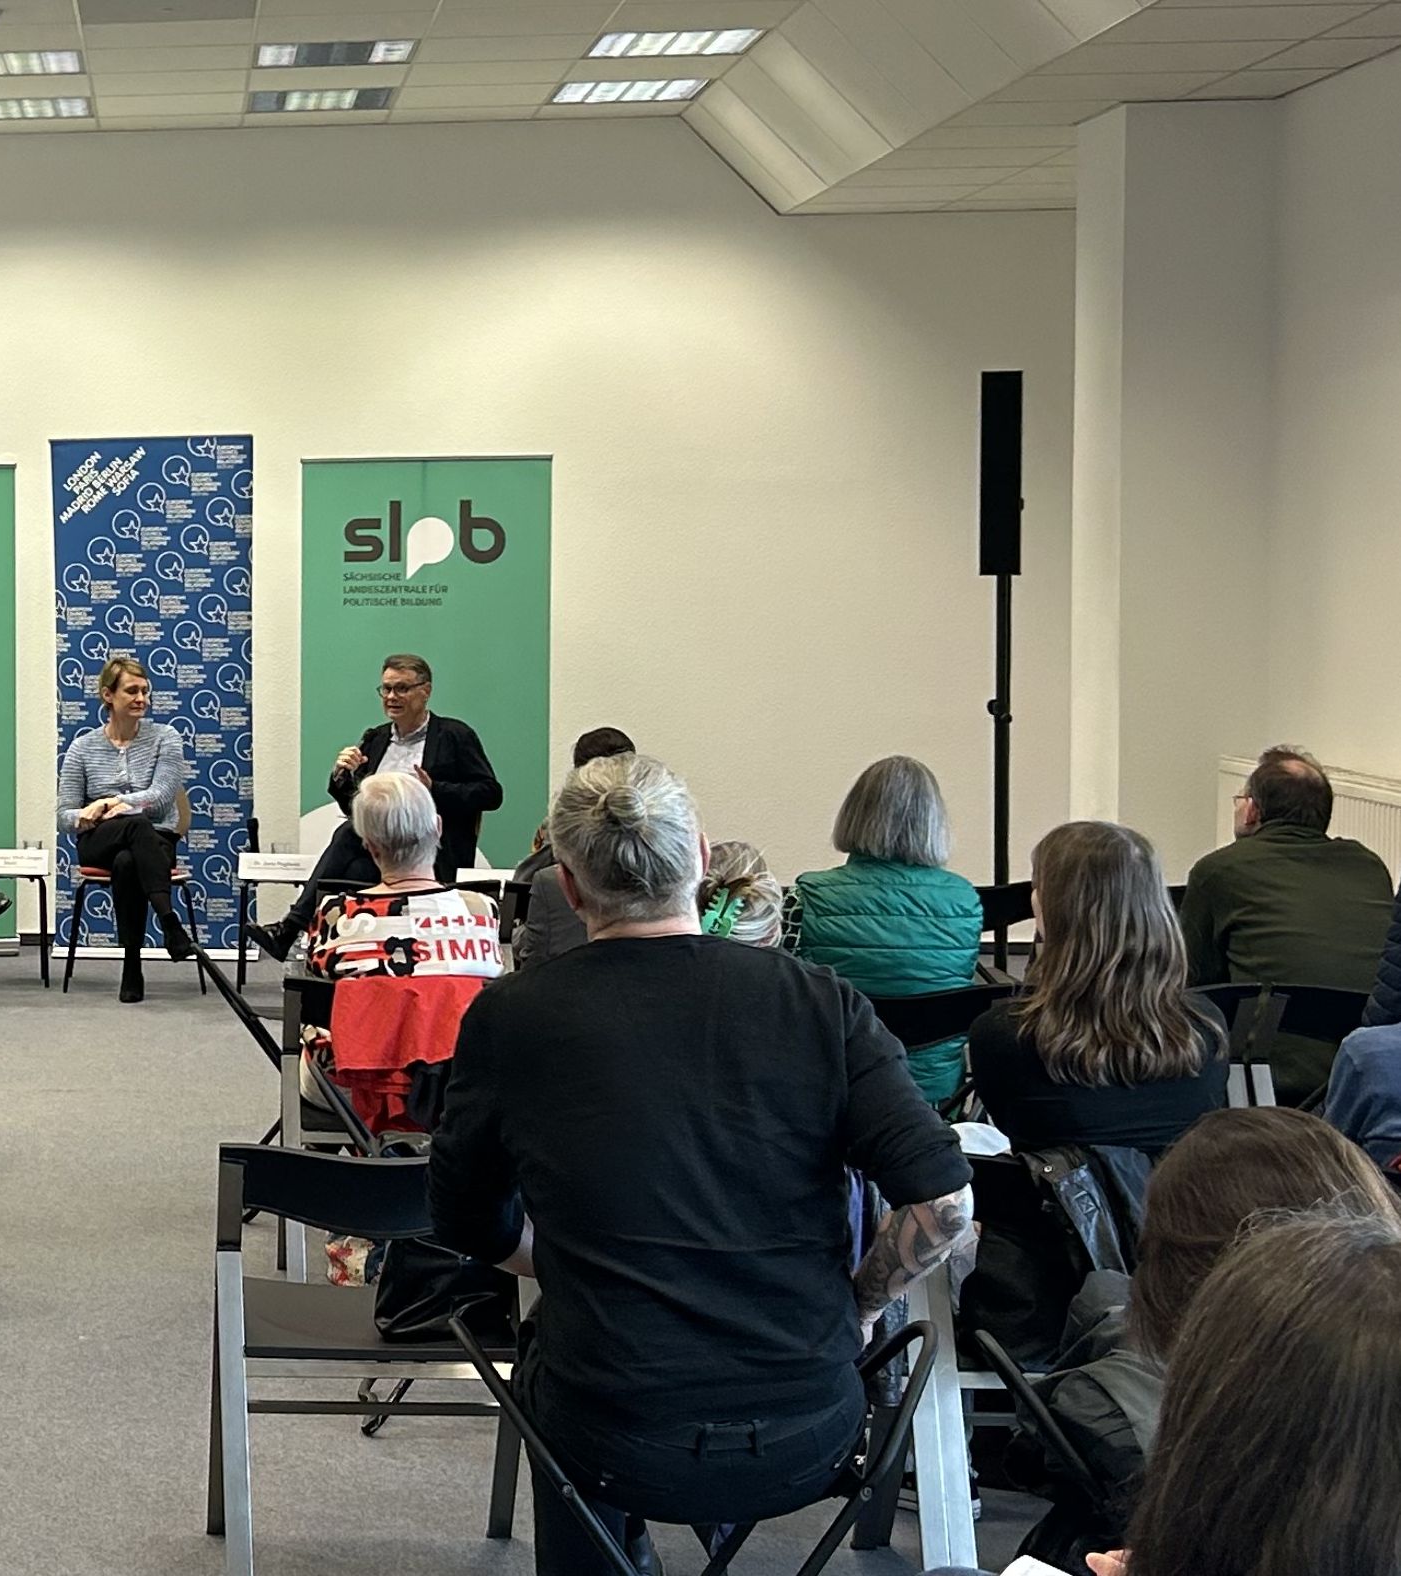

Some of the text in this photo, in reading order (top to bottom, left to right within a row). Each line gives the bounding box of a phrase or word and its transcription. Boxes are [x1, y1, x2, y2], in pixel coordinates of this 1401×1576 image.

[63, 451, 102, 491] LONDON
[73, 468, 99, 495] PARIS
[81, 446, 147, 514] ROME WARSAW
[111, 469, 140, 497] SOFIA
[59, 456, 124, 524] MADRID BERLIN
[343, 572, 401, 582] SÄCHSISCHE
[343, 584, 448, 594] LANDESZENTRALE FÜR
[343, 597, 443, 607] POLITISCHE BILDUNG
[411, 915, 477, 936] KEEP
